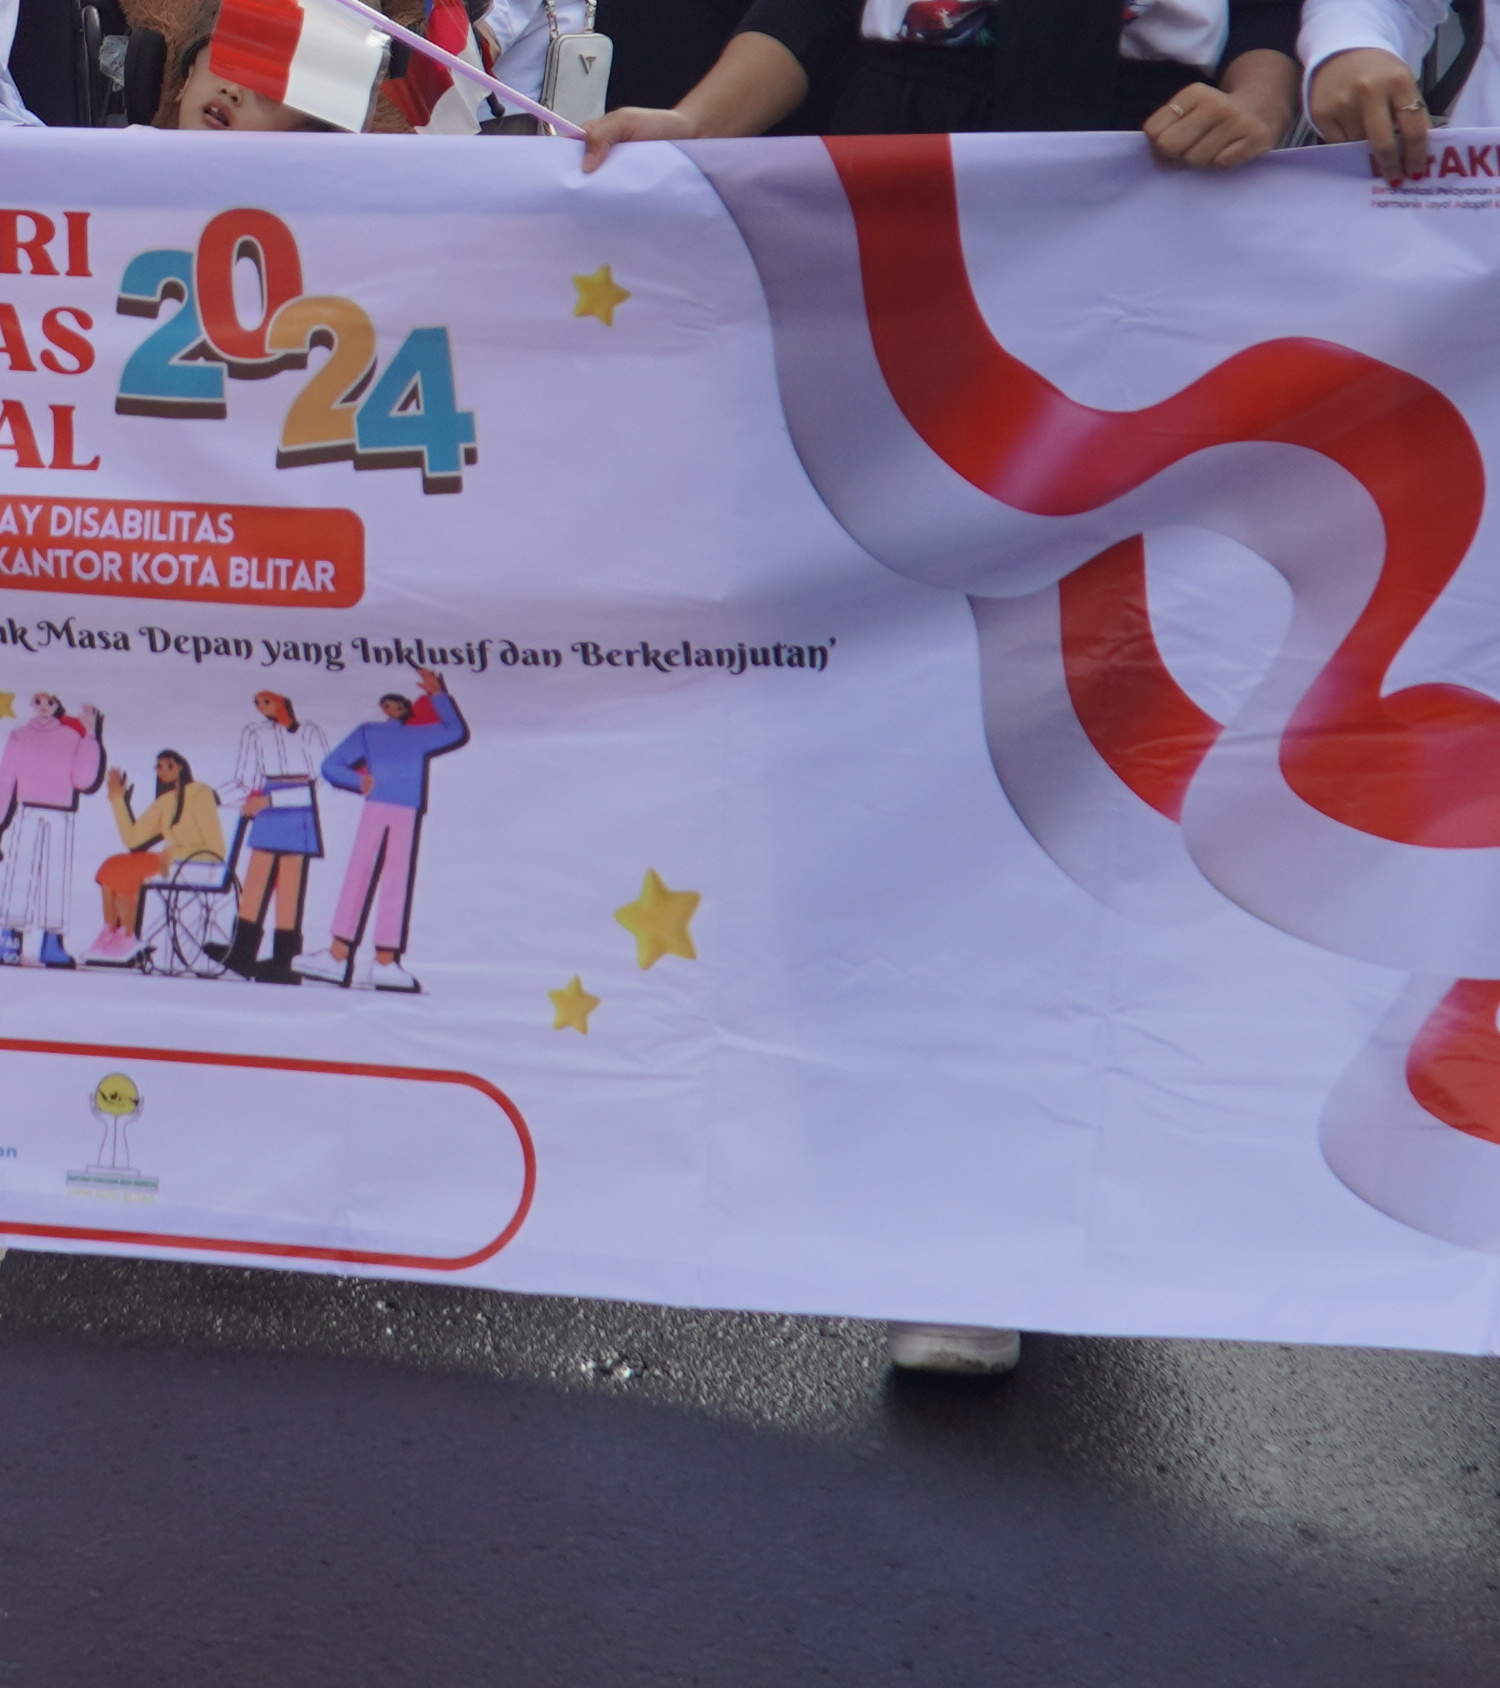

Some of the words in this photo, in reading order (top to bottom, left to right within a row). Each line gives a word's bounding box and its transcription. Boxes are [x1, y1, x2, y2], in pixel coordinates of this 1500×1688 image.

[113, 206, 479, 495] 2024
[47, 503, 236, 546] DISABILITAS
[127, 547, 222, 591] KOTA
[227, 552, 336, 593] BLITAR
[34, 613, 132, 654] Masa
[138, 623, 254, 664] Depan
[261, 631, 347, 673] yang
[351, 633, 491, 677] Inklusif
[497, 634, 563, 671] dan
